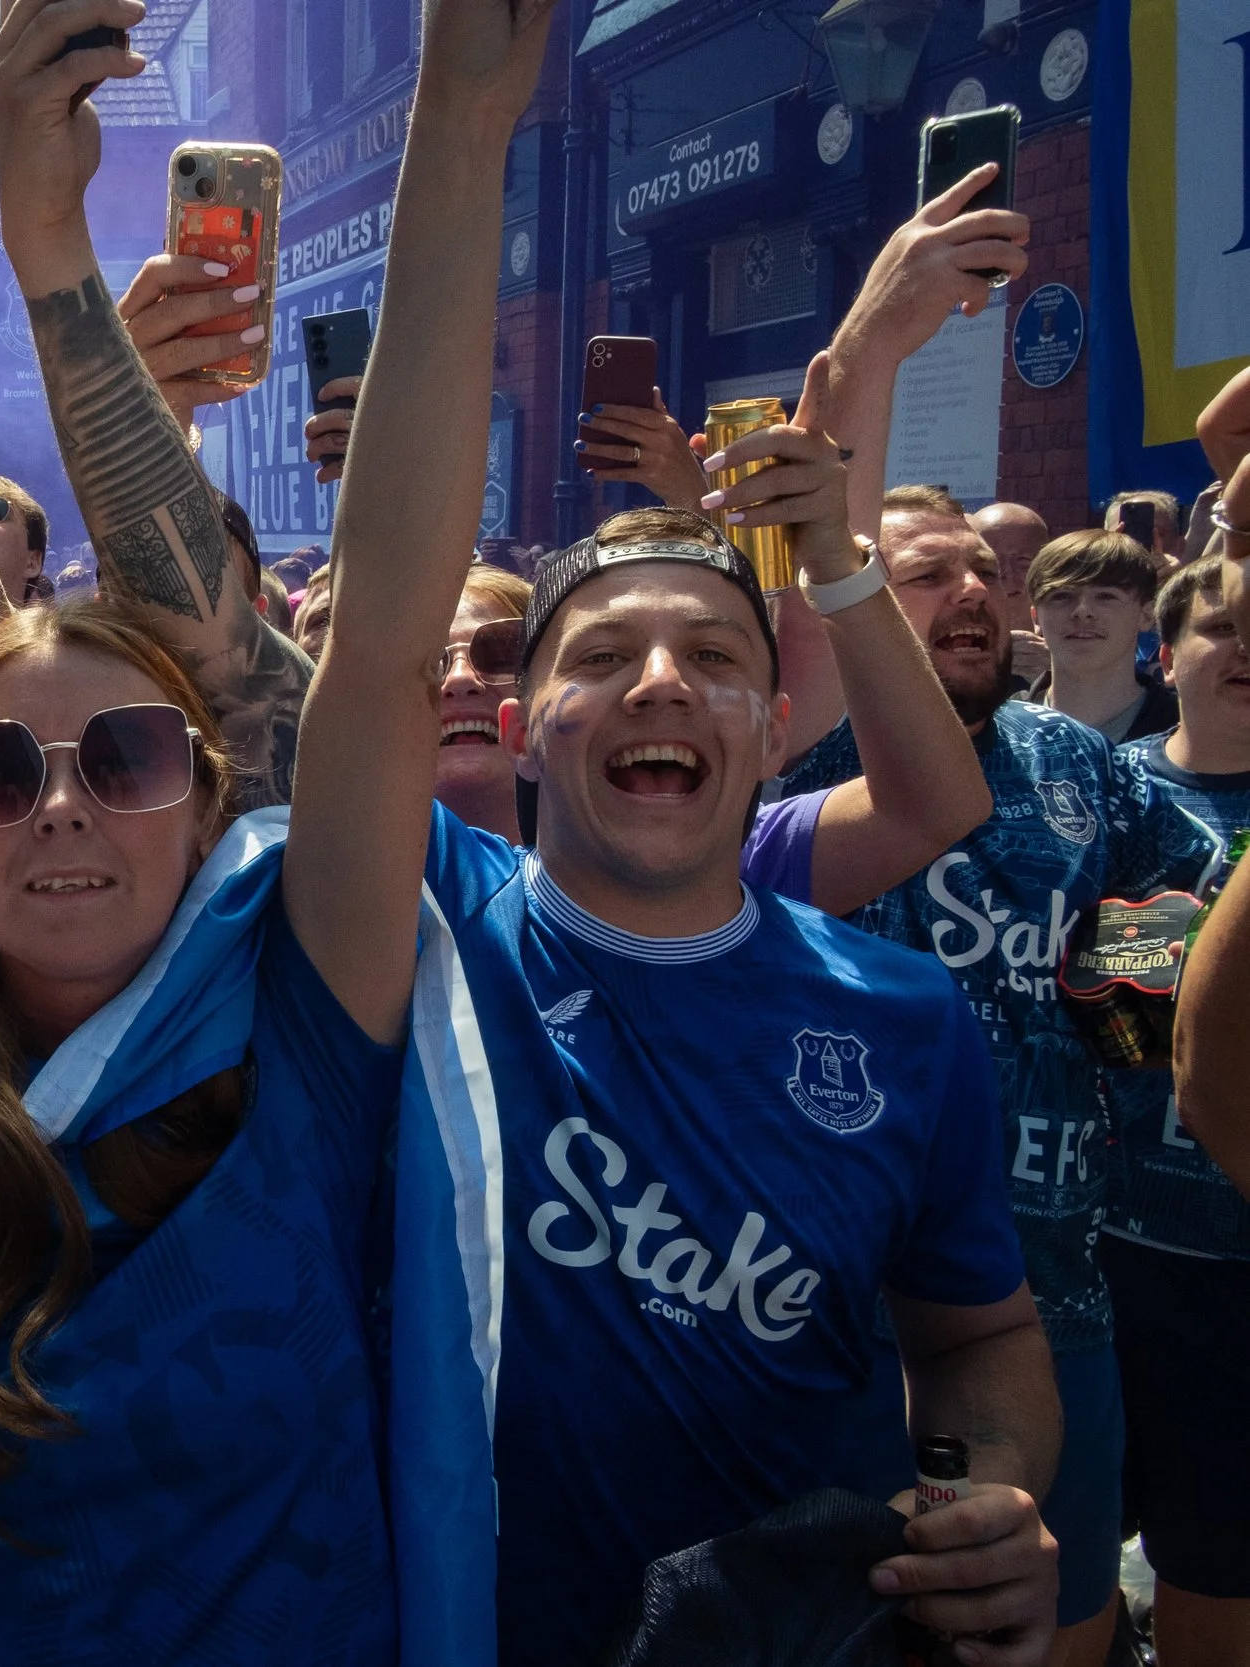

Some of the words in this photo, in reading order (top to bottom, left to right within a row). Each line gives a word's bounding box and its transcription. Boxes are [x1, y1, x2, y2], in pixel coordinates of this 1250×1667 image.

[669, 132, 711, 163] Contact
[628, 170, 680, 214] 07473
[688, 141, 760, 193] 091278
[292, 211, 372, 278] PEOPLES
[16, 370, 42, 380] Welc
[3, 388, 41, 399] Bramley
[996, 803, 1034, 819] 1928
[1077, 948, 1174, 972] KOPPARBERG
[809, 1083, 859, 1102] Everton
[828, 1101, 845, 1110] 1878
[795, 1092, 806, 1107] NIL
[806, 1106, 828, 1123] SATIS
[830, 1119, 848, 1128] NISI
[849, 1103, 877, 1127] OPTIMUM
[1011, 1115, 1095, 1186] EFC
[527, 1117, 821, 1342] Stake
[639, 1297, 698, 1328] .com
